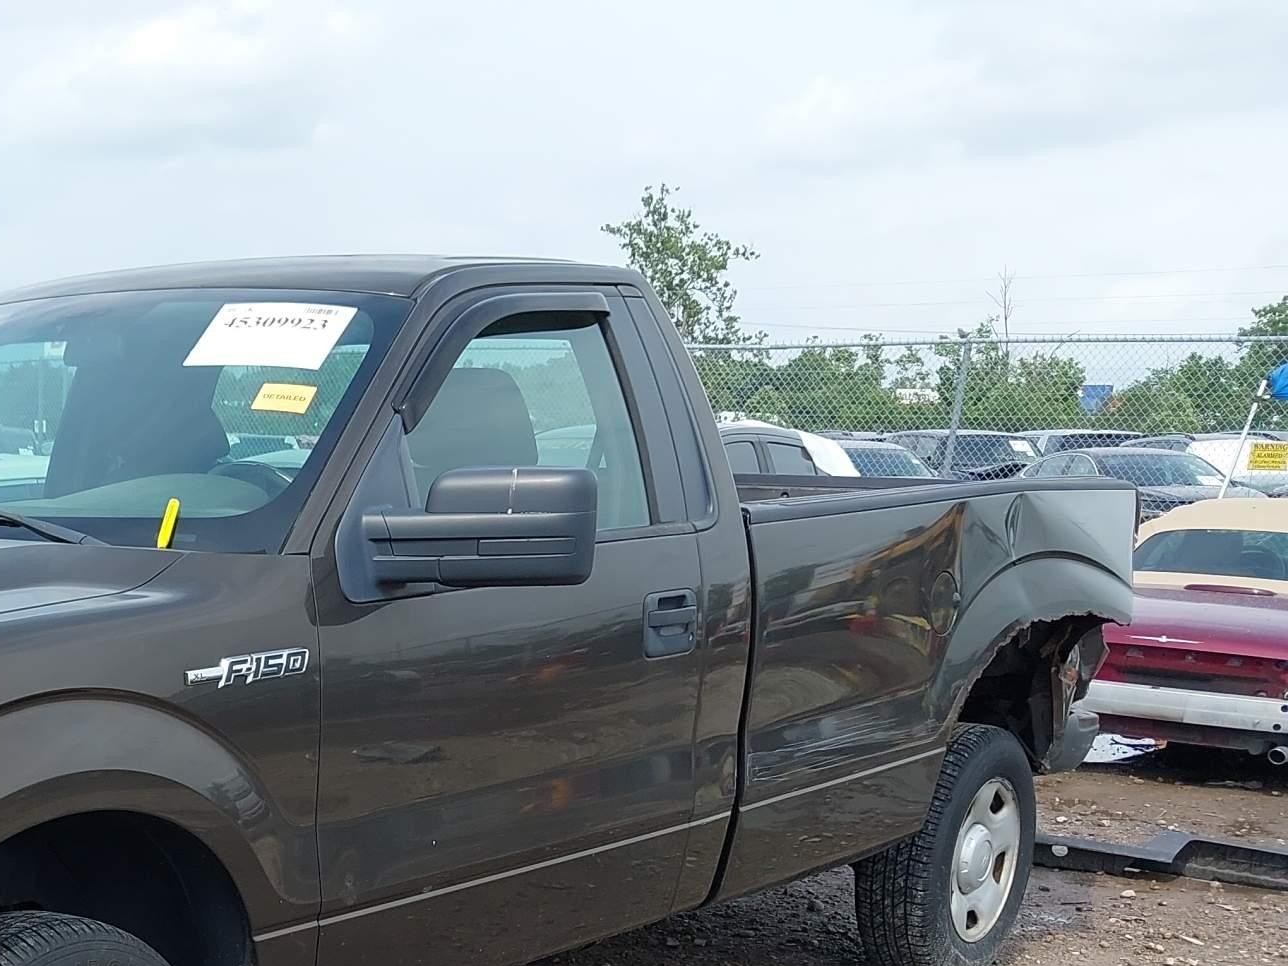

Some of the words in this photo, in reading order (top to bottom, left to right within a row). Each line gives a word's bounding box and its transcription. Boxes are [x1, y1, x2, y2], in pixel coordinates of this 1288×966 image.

[224, 316, 328, 330] 45309923
[263, 393, 306, 402] DETAILED
[192, 673, 208, 681] XL
